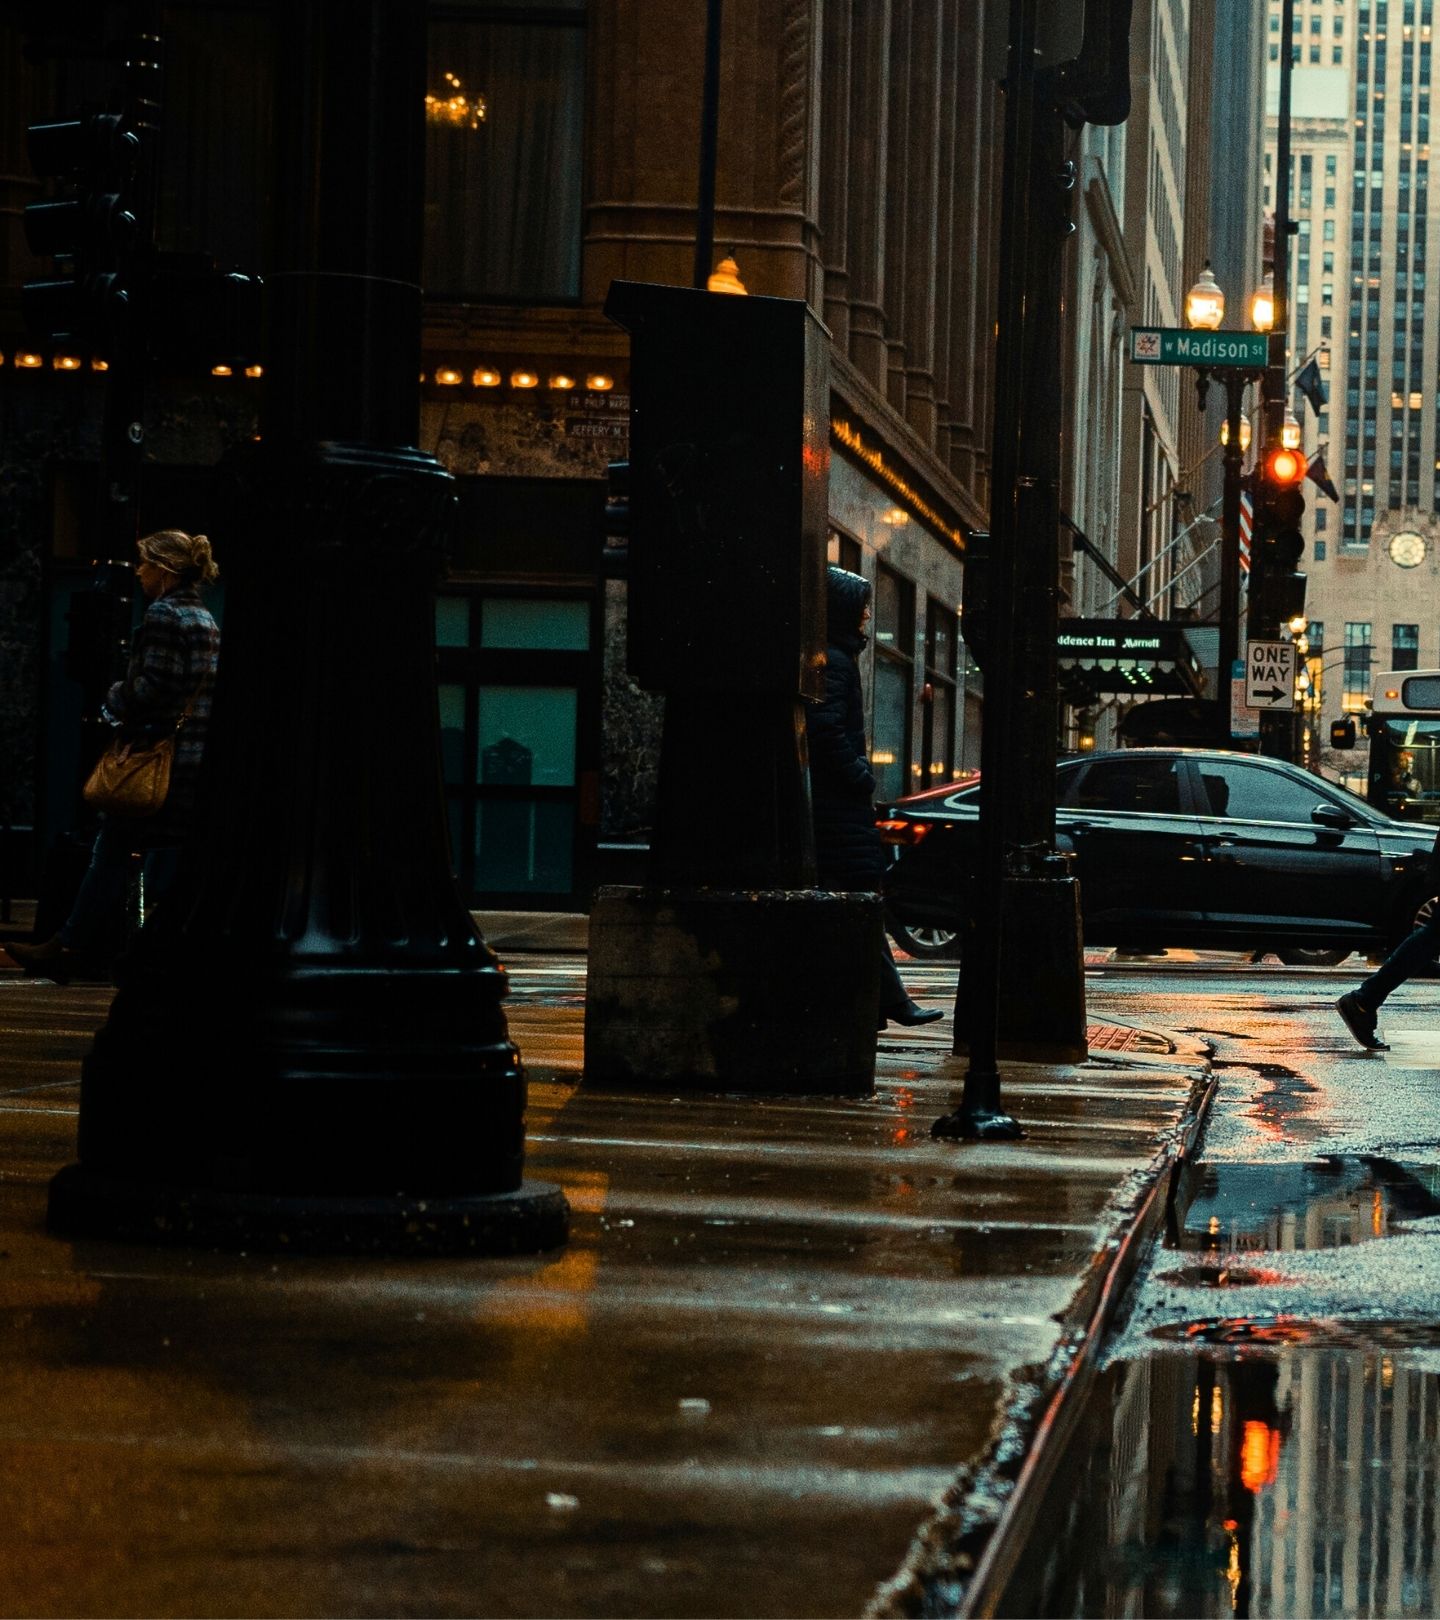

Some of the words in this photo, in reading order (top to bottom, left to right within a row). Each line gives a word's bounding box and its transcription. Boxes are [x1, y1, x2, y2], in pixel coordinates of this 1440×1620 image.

[1165, 342, 1173, 351] W
[1177, 337, 1248, 358] Madison
[1252, 345, 1263, 356] St
[1096, 635, 1117, 647] Inn
[1253, 647, 1290, 664] ONE
[1252, 665, 1290, 682] WAY
